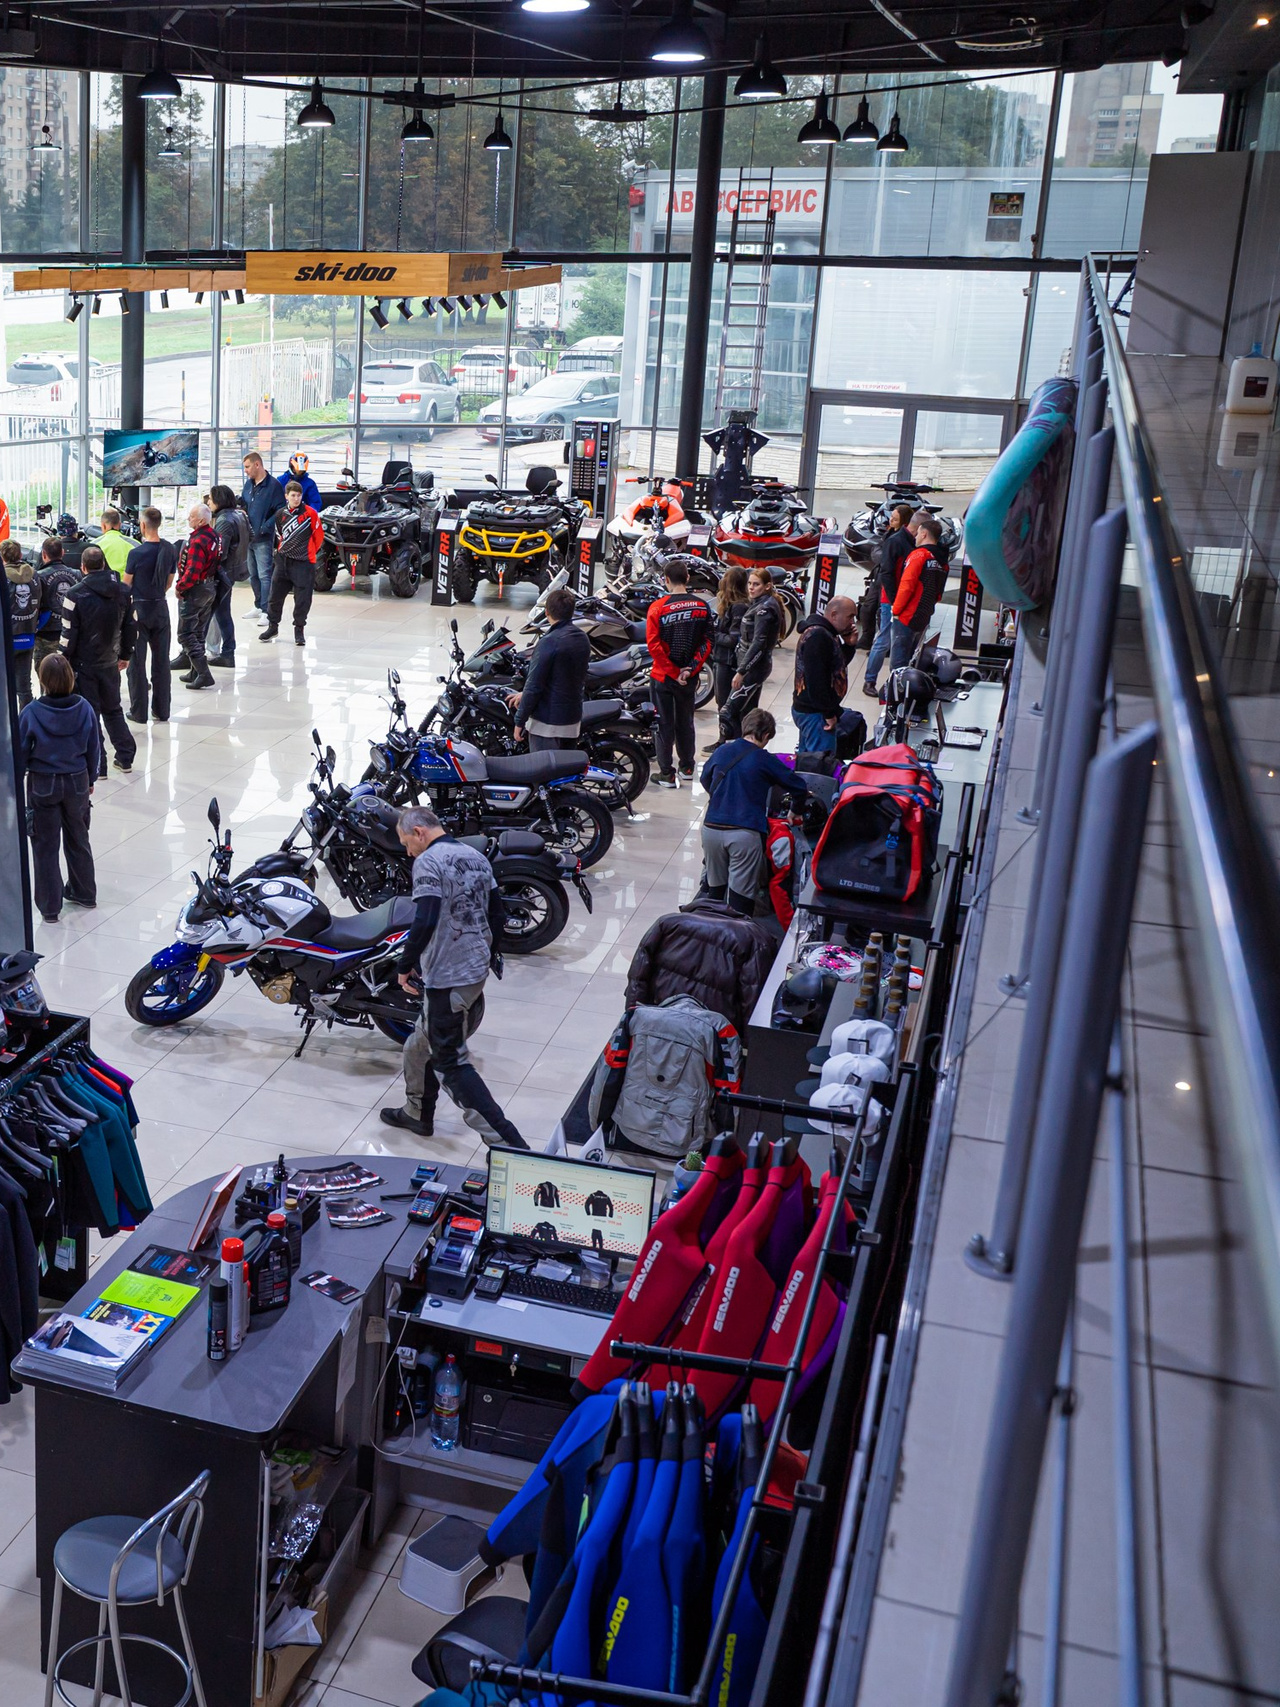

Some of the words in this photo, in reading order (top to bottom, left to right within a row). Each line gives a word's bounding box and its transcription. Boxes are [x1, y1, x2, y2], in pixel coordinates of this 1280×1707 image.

[665, 188, 818, 214] АВСЕРВИС
[294, 262, 398, 282] ski-doo
[437, 532, 451, 595] VETERR
[578, 540, 592, 598] ETERR
[670, 601, 698, 610] ФОМИН
[661, 609, 708, 625] VETERR
[839, 878, 853, 888] LTD
